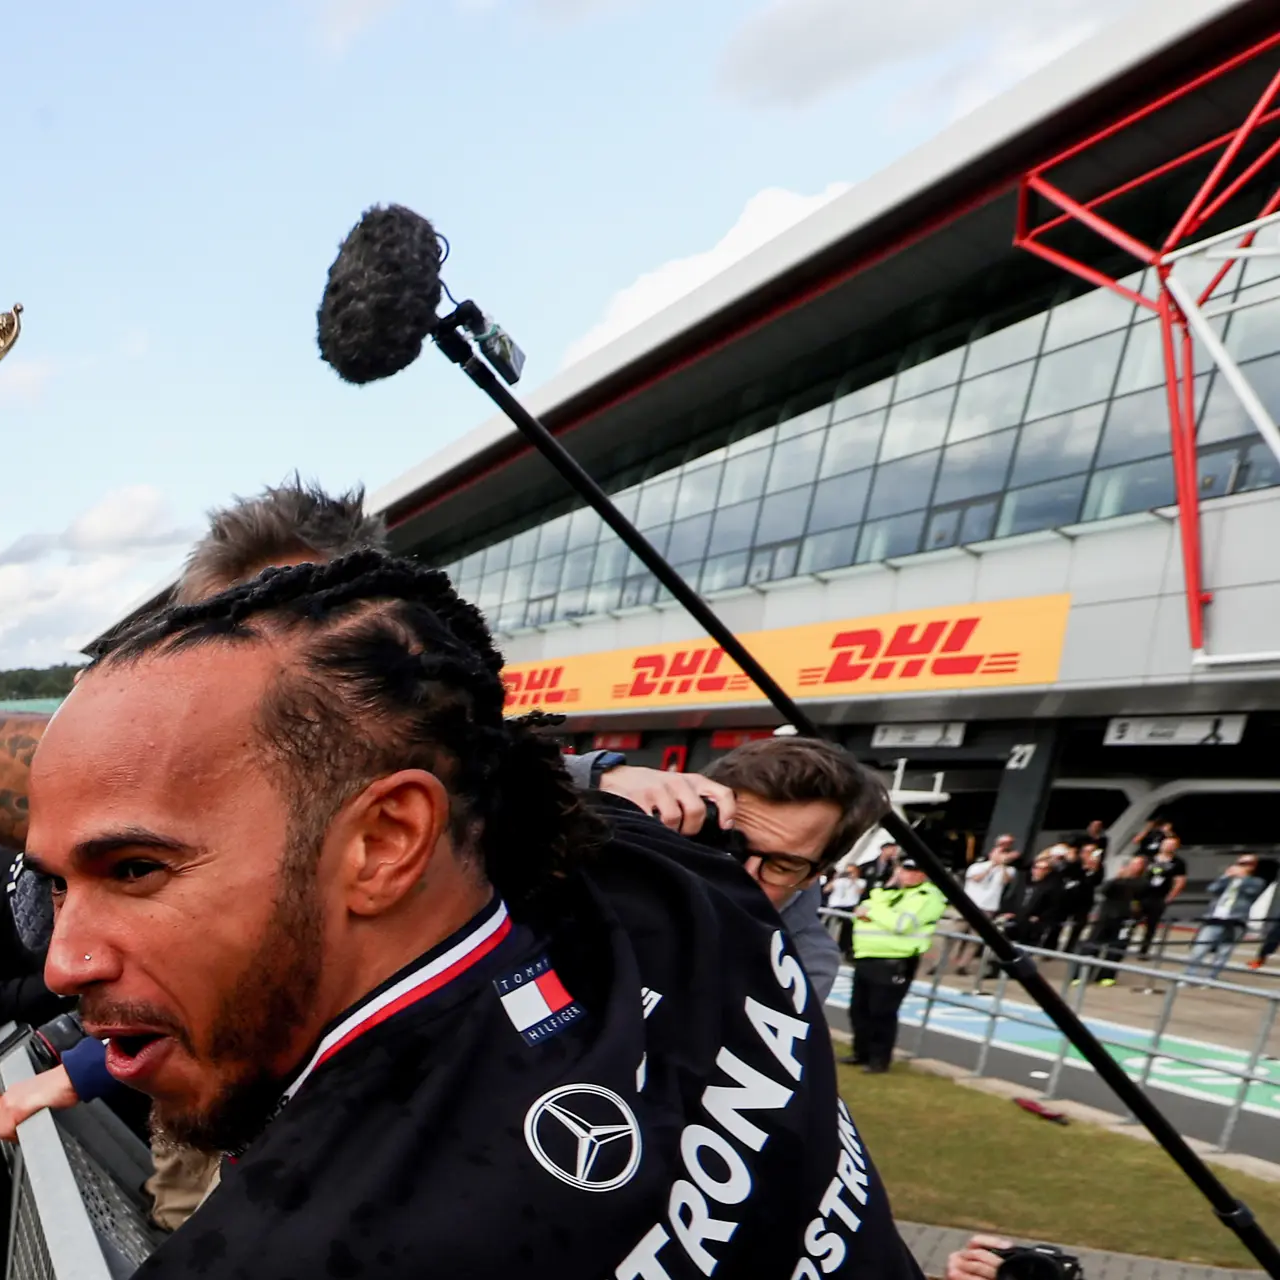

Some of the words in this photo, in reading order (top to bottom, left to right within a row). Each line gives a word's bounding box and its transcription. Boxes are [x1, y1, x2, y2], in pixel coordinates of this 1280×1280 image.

[824, 618, 983, 685] DHL
[503, 666, 567, 706] DHL
[628, 648, 730, 697] DHL
[500, 958, 550, 990] TOMMY
[527, 1005, 582, 1041] HILFIGER
